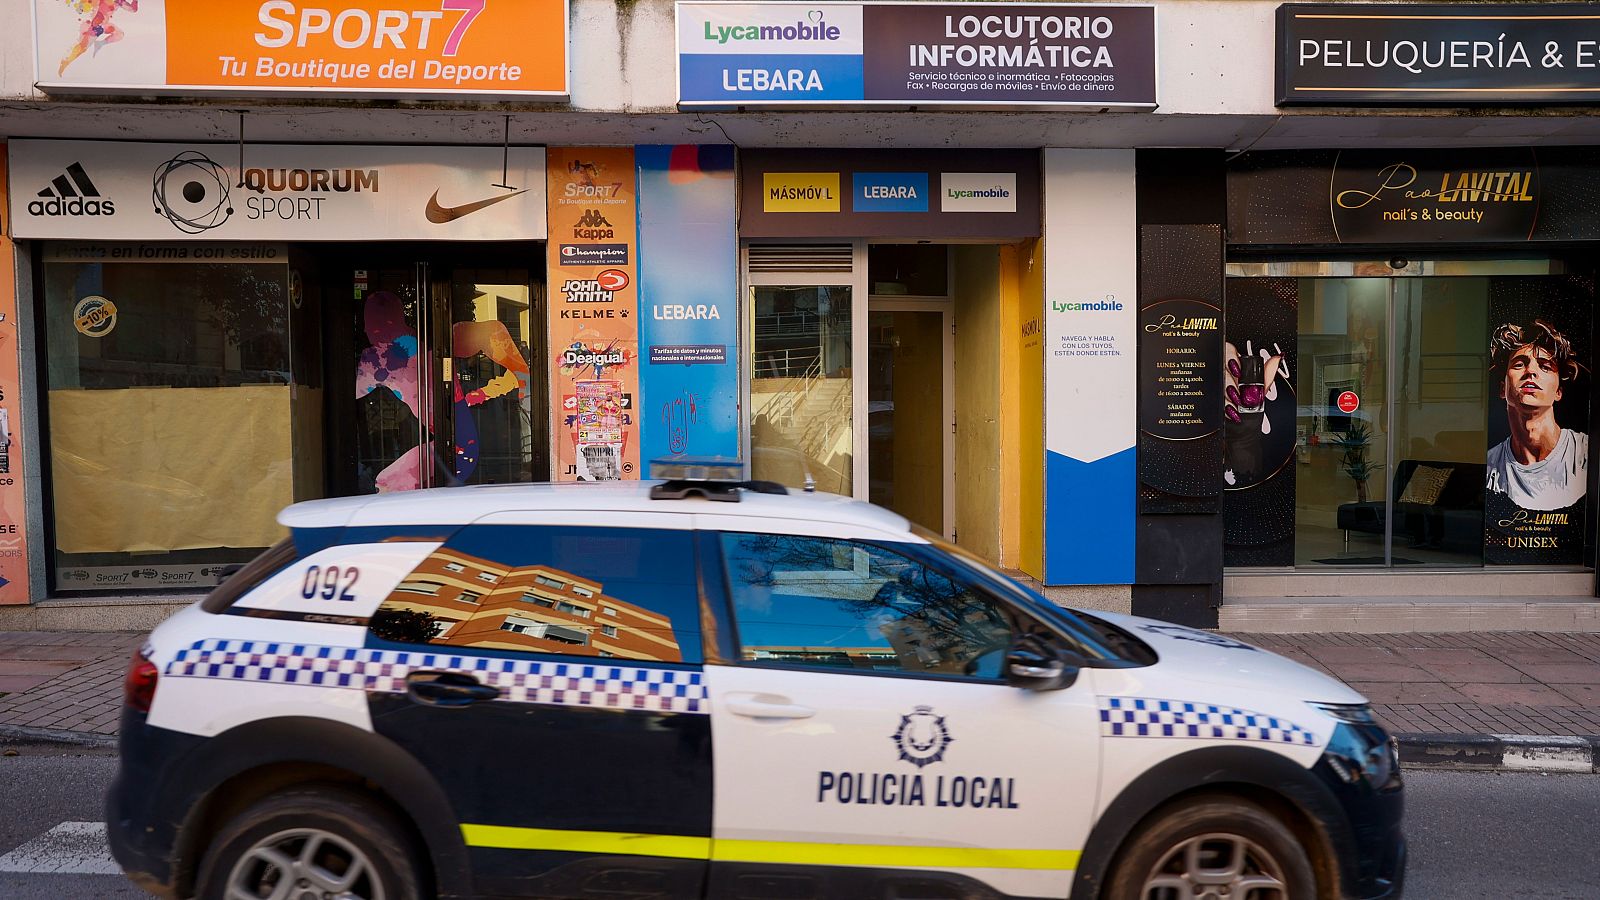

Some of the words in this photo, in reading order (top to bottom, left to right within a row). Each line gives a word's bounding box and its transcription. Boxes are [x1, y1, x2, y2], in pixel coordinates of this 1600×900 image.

[254, 0, 486, 57] SPORT7
[704, 17, 840, 43] Lycamobile
[945, 15, 1113, 40] LOCUTORIO
[910, 38, 1114, 68] INFORMÁTICA
[1300, 33, 1532, 74] PELUQUERÍA
[1541, 40, 1564, 68] &
[1576, 40, 1600, 68] E
[218, 56, 247, 77] Tu
[255, 57, 370, 82] Boutique
[378, 59, 416, 79] del
[424, 60, 522, 84] Deporte
[723, 69, 823, 91] LEBARA
[909, 72, 947, 81] Servicio
[949, 72, 986, 82] técnico
[997, 72, 1050, 82] inormática
[1061, 73, 1114, 84] Fotocopias
[907, 82, 923, 90] Fax
[932, 82, 978, 92] Recargas
[981, 82, 993, 90] de
[996, 82, 1033, 91] móviles
[1041, 82, 1066, 91] Envío
[1069, 83, 1081, 91] de
[1085, 83, 1115, 91] dinero
[244, 168, 379, 193] QUORUM
[1438, 172, 1533, 202] LAVITAL
[565, 183, 622, 198] SPORT7
[864, 186, 917, 199] LEBARA
[948, 188, 1010, 200] Lycamobile
[28, 197, 115, 216] adidas
[246, 198, 326, 219] SPORT
[1421, 209, 1432, 220] &
[1435, 208, 1483, 223] beauty
[574, 229, 613, 240] Kappa
[112, 247, 132, 258] en
[139, 245, 187, 259] forma
[194, 248, 224, 258] con
[230, 244, 277, 258] estilo
[562, 246, 625, 259] Champion
[567, 291, 612, 302] SMITH
[653, 305, 721, 320] LEBARA
[1052, 300, 1123, 312] Lycamobile
[82, 306, 109, 326] -10%
[560, 310, 615, 318] KELME
[1183, 318, 1217, 330] LAVITAL
[566, 352, 624, 366] Desigual
[1535, 513, 1569, 525] LAVITAL
[1507, 537, 1558, 548] UNISEX
[96, 573, 129, 582] SPORT7
[161, 572, 194, 580] SPORT7
[301, 565, 359, 601] 092
[817, 771, 925, 806] POLICIA
[935, 776, 1020, 809] LOCAL
